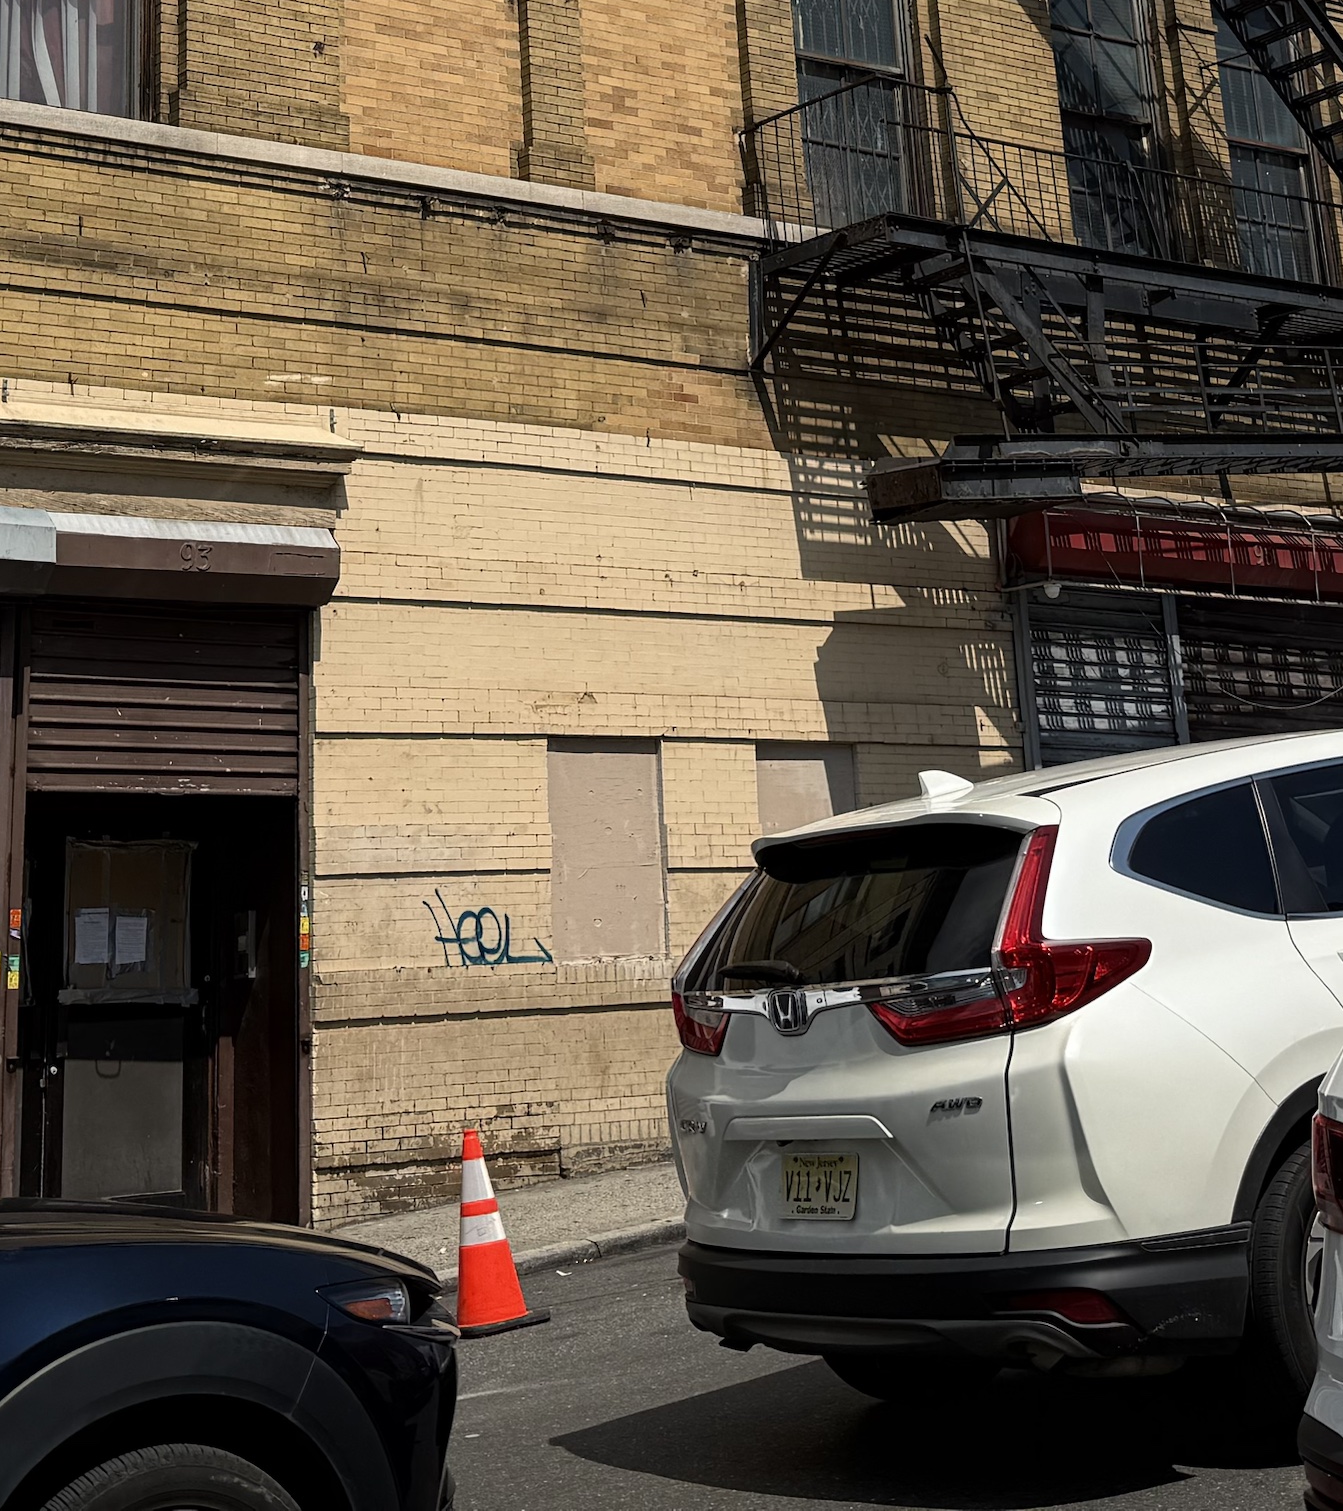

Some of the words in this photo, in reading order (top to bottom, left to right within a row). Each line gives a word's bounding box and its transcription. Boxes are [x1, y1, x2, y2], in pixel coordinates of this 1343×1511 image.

[179, 542, 213, 572] 93
[930, 1096, 983, 1113] AWD
[798, 1156, 814, 1168] New
[815, 1156, 838, 1169] Jersey
[796, 1205, 819, 1214] Garden
